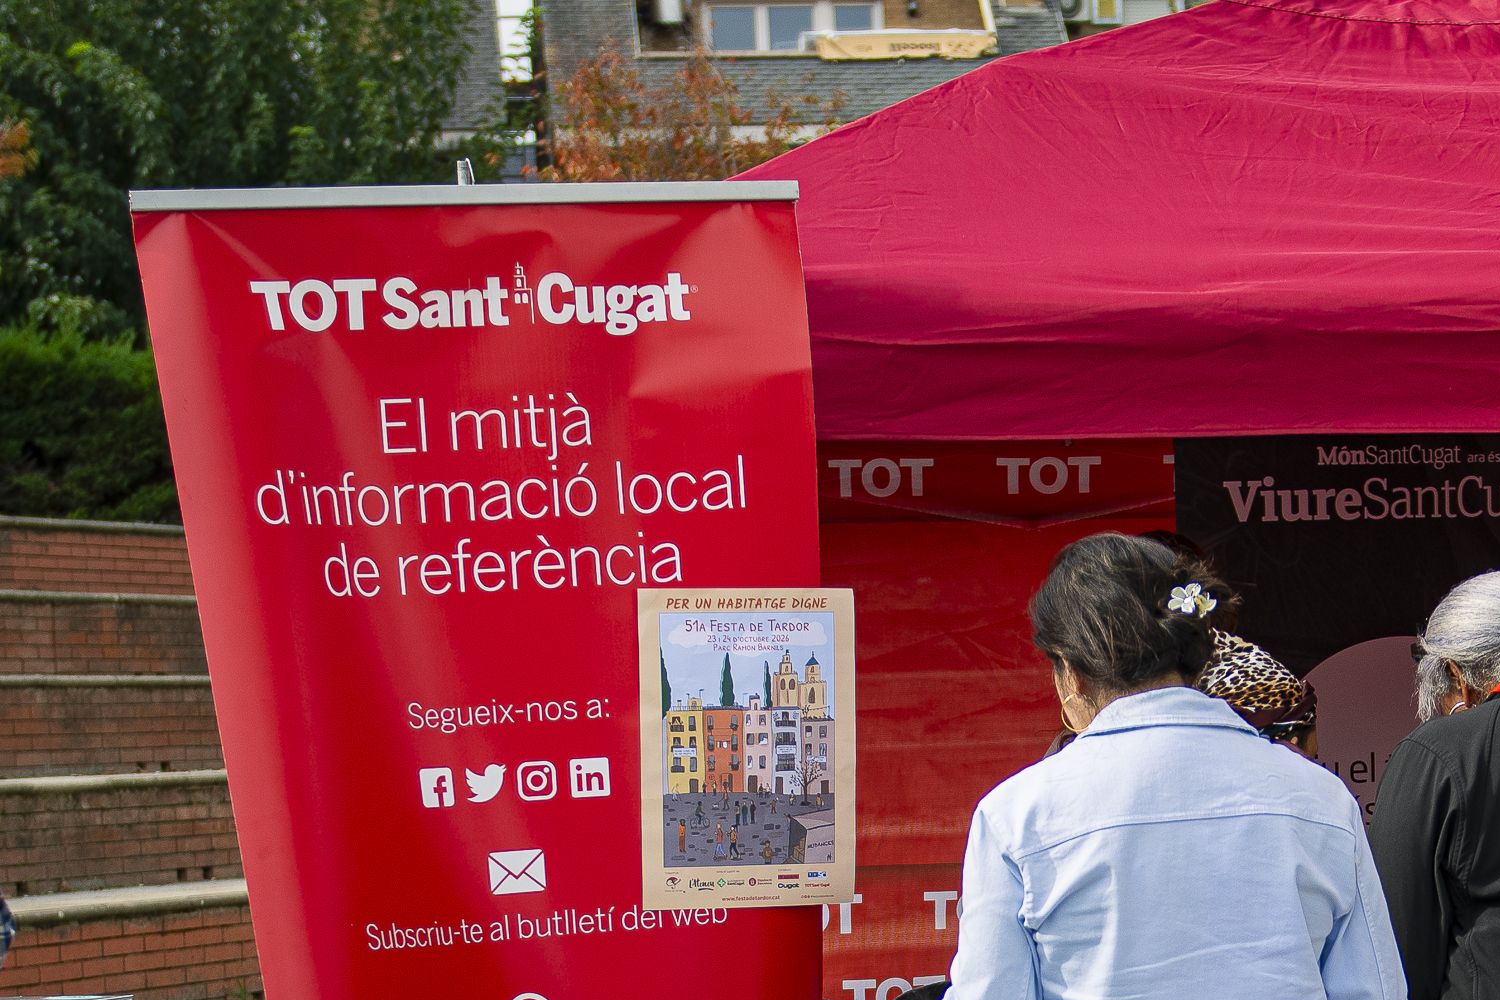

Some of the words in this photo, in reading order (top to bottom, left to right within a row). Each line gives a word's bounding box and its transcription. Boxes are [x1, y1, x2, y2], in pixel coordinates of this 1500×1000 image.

[250, 278, 377, 332] TOT
[382, 276, 510, 331] Sant
[537, 272, 691, 336] Cugat
[379, 396, 428, 454] El
[450, 392, 592, 461] mitjà
[997, 456, 1102, 494] TOT
[1467, 453, 1486, 463] ara
[257, 462, 598, 527] d'informació
[616, 455, 747, 516] local
[829, 458, 934, 498] TOT
[323, 541, 381, 598] de
[398, 530, 684, 597] referència
[666, 598, 690, 610] PER
[695, 598, 712, 609] UN
[717, 597, 787, 610] HABITATGE
[791, 597, 828, 609] DIGNE
[707, 635, 717, 643] 23
[749, 622, 763, 632] DE
[408, 696, 577, 735] Segueix-nos
[585, 696, 612, 722] a:
[365, 919, 484, 951] Subscriu-te
[489, 916, 511, 942] al
[517, 904, 615, 939] butlletí
[671, 906, 728, 927] web
